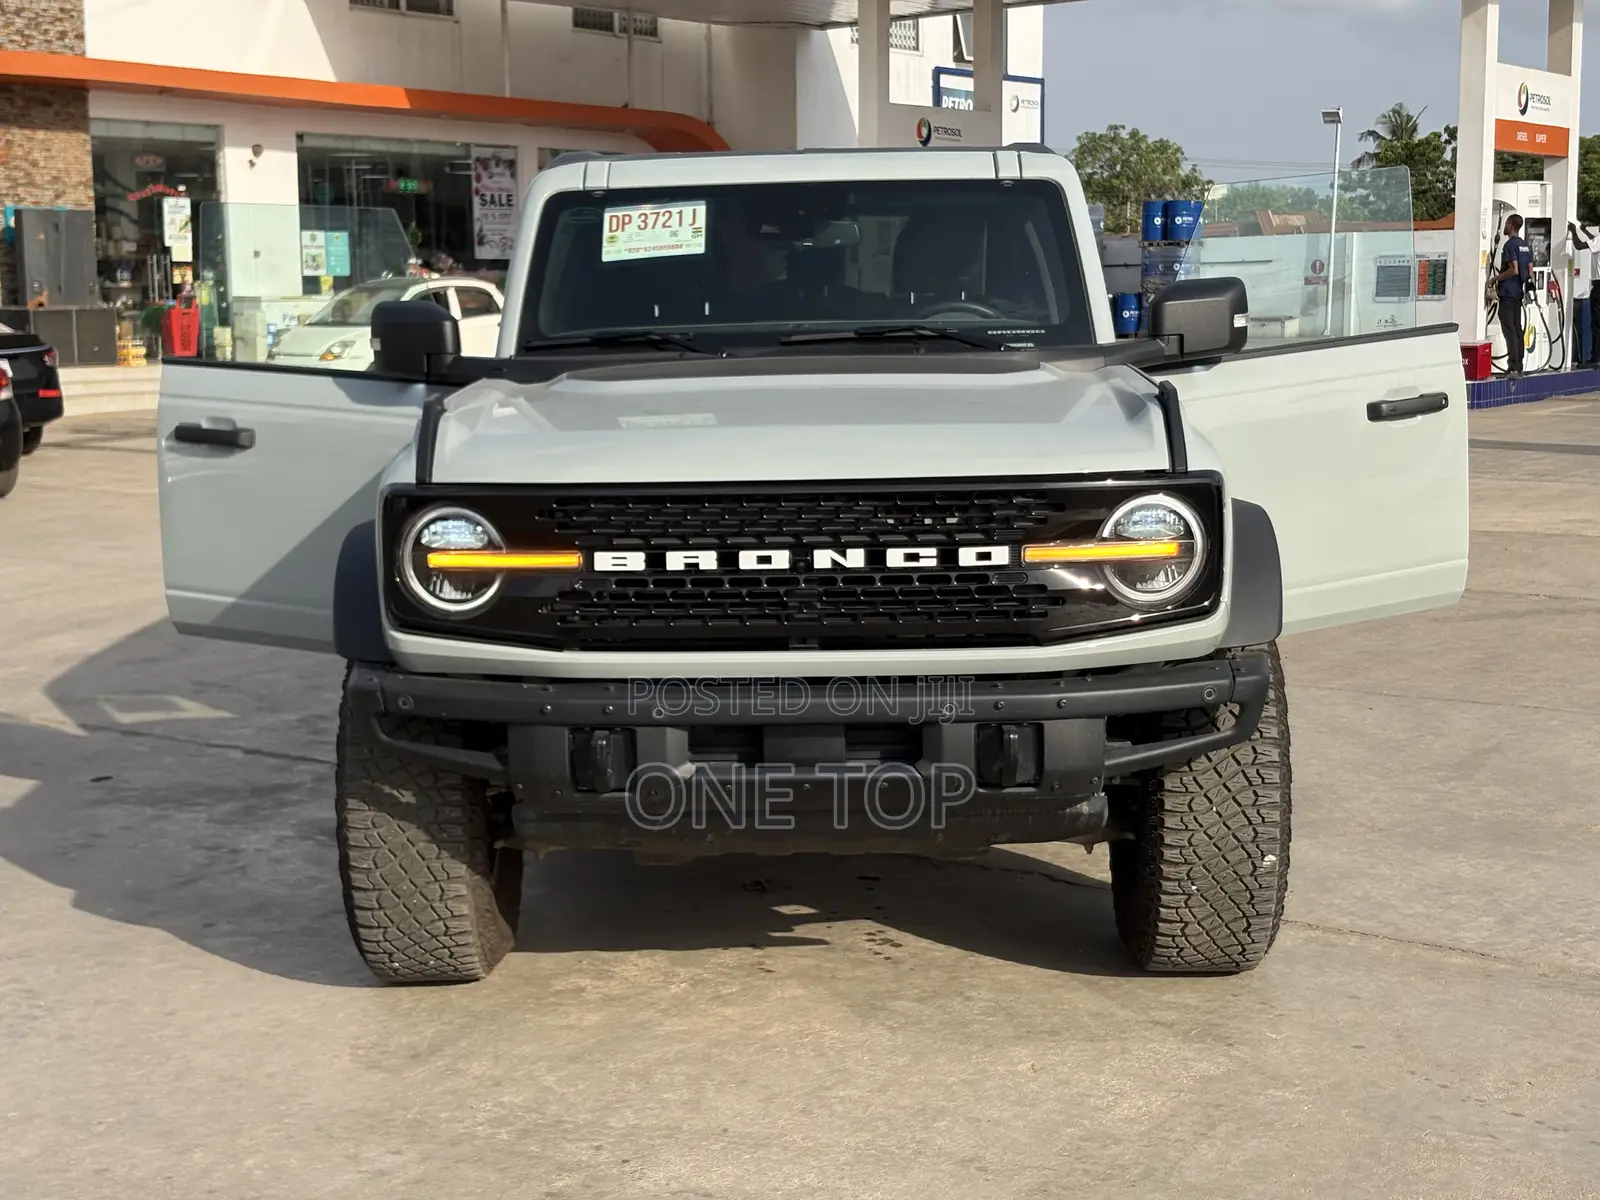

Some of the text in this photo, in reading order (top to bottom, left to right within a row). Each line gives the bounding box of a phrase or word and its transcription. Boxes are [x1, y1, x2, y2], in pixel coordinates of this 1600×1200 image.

[1529, 92, 1552, 106] PETROSOL
[933, 125, 963, 138] PETROSOL
[479, 193, 514, 208] SALE
[608, 208, 698, 233] DP 3721 J
[593, 545, 1010, 572] BRONCO
